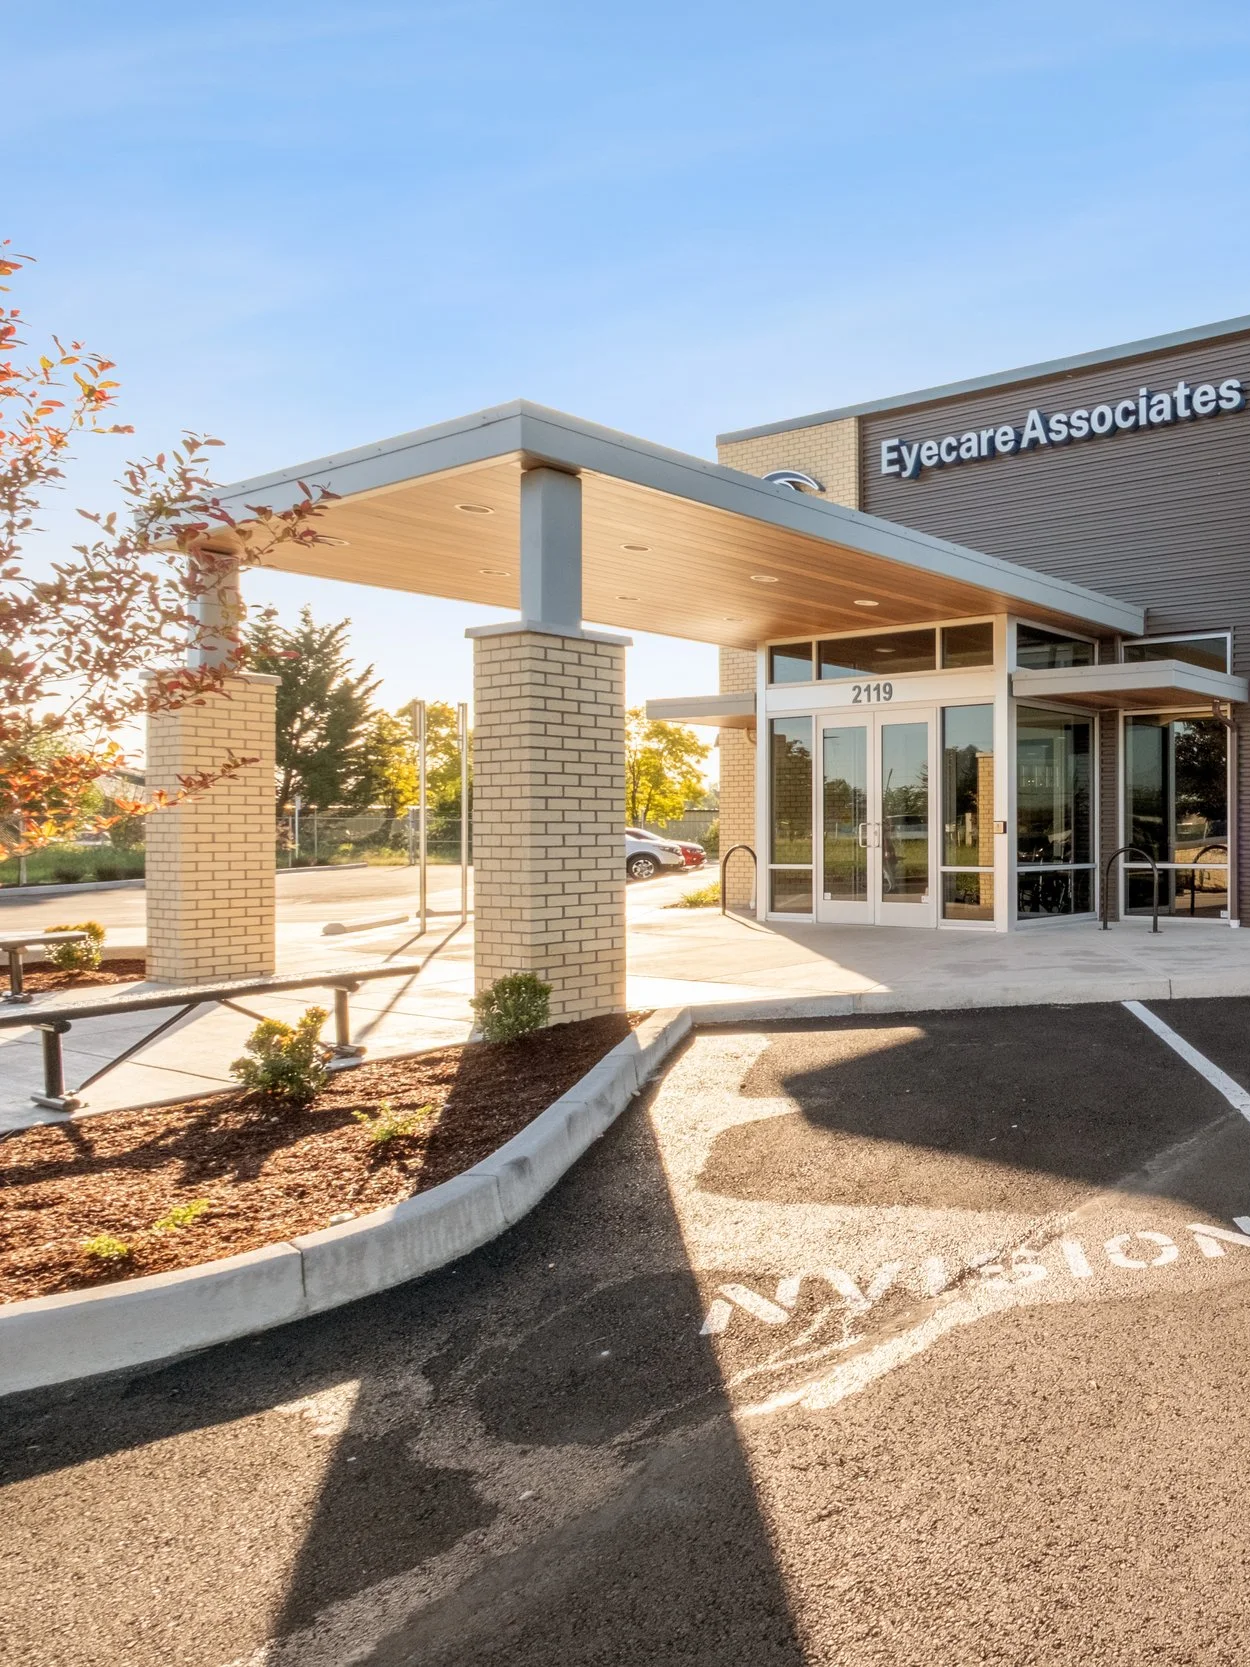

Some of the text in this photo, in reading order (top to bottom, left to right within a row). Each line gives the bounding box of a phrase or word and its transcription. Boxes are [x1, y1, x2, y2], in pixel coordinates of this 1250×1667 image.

[880, 378, 1243, 479] Eyecare Associates
[851, 681, 893, 704] 2119
